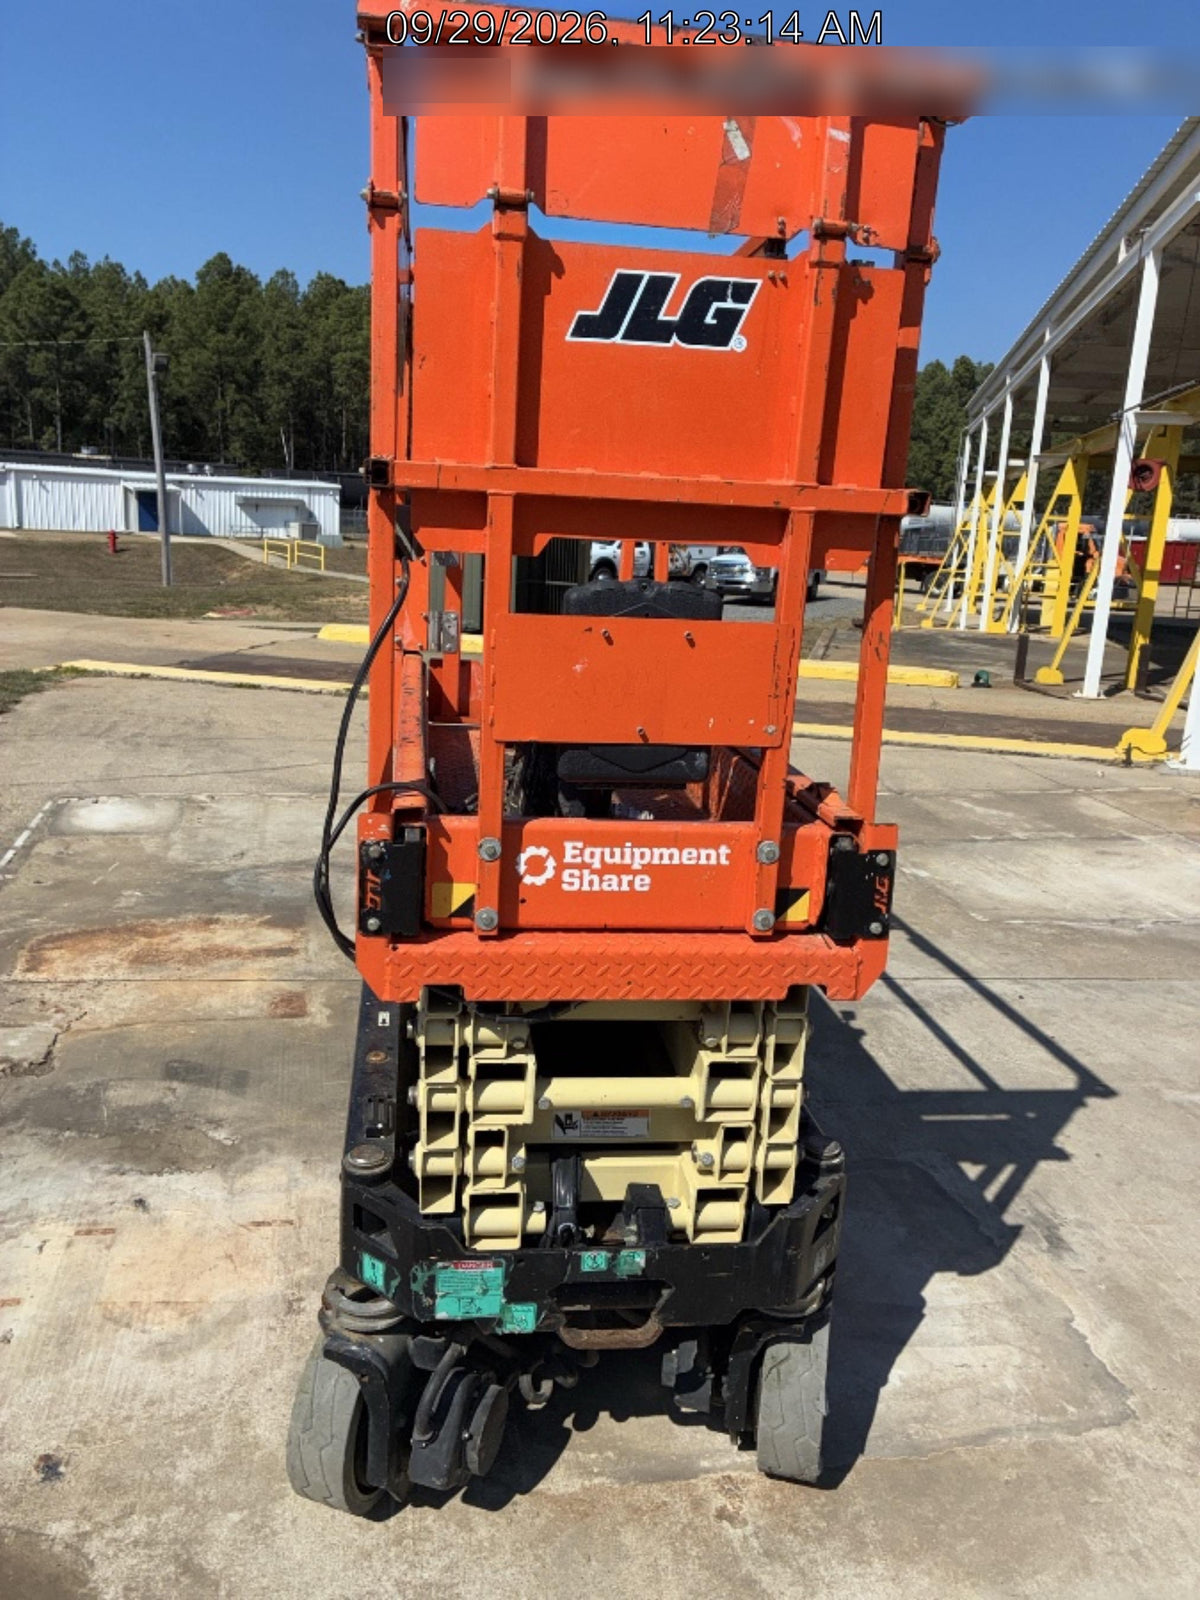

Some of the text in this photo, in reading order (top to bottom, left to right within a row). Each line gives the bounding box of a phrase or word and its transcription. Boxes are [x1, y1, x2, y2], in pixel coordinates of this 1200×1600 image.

[565, 268, 763, 351] JLG
[563, 841, 732, 870] Equipment
[561, 868, 652, 892] Share
